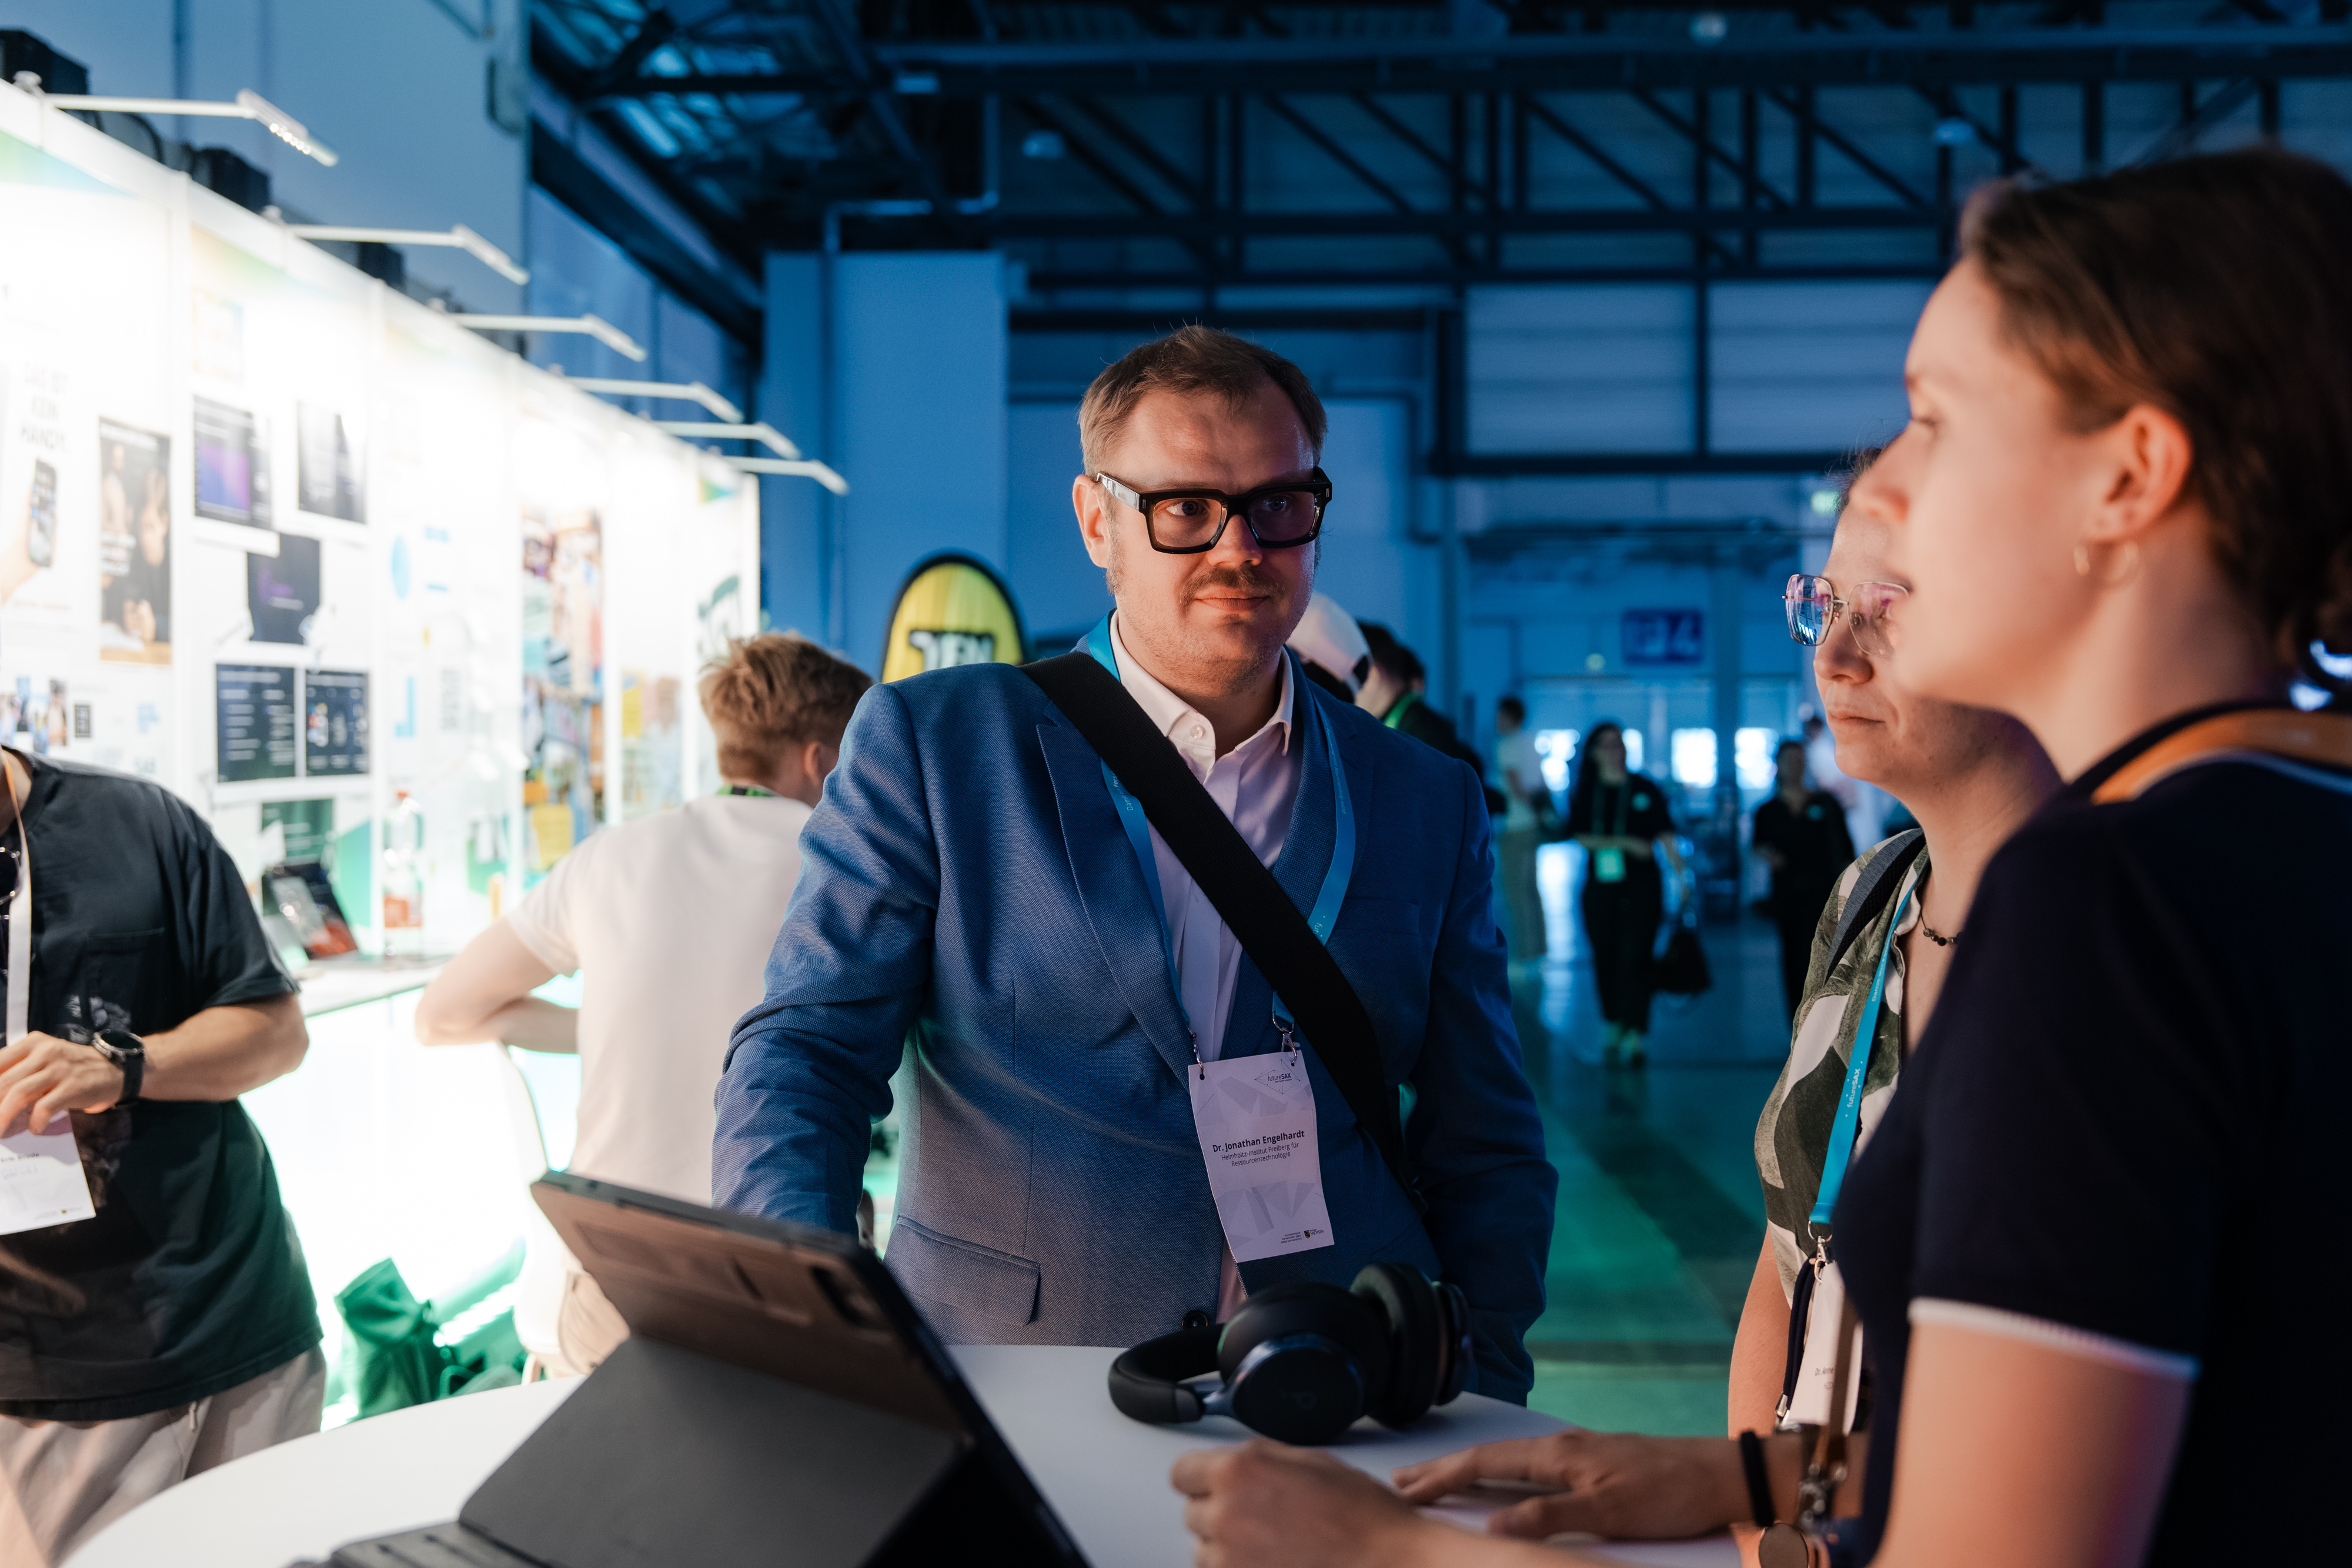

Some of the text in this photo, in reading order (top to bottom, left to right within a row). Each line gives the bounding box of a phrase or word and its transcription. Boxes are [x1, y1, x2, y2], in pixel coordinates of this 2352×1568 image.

[1267, 1072, 1292, 1082] futureSAX
[1846, 1068, 1861, 1108] futureSAX
[1212, 1129, 1305, 1152] Dr. Jonathan Engelhardt
[1221, 1148, 1268, 1161] Helmholtz-Institut
[1268, 1144, 1291, 1153] Freiberg
[1231, 1151, 1291, 1167] Ressourcentechnologie
